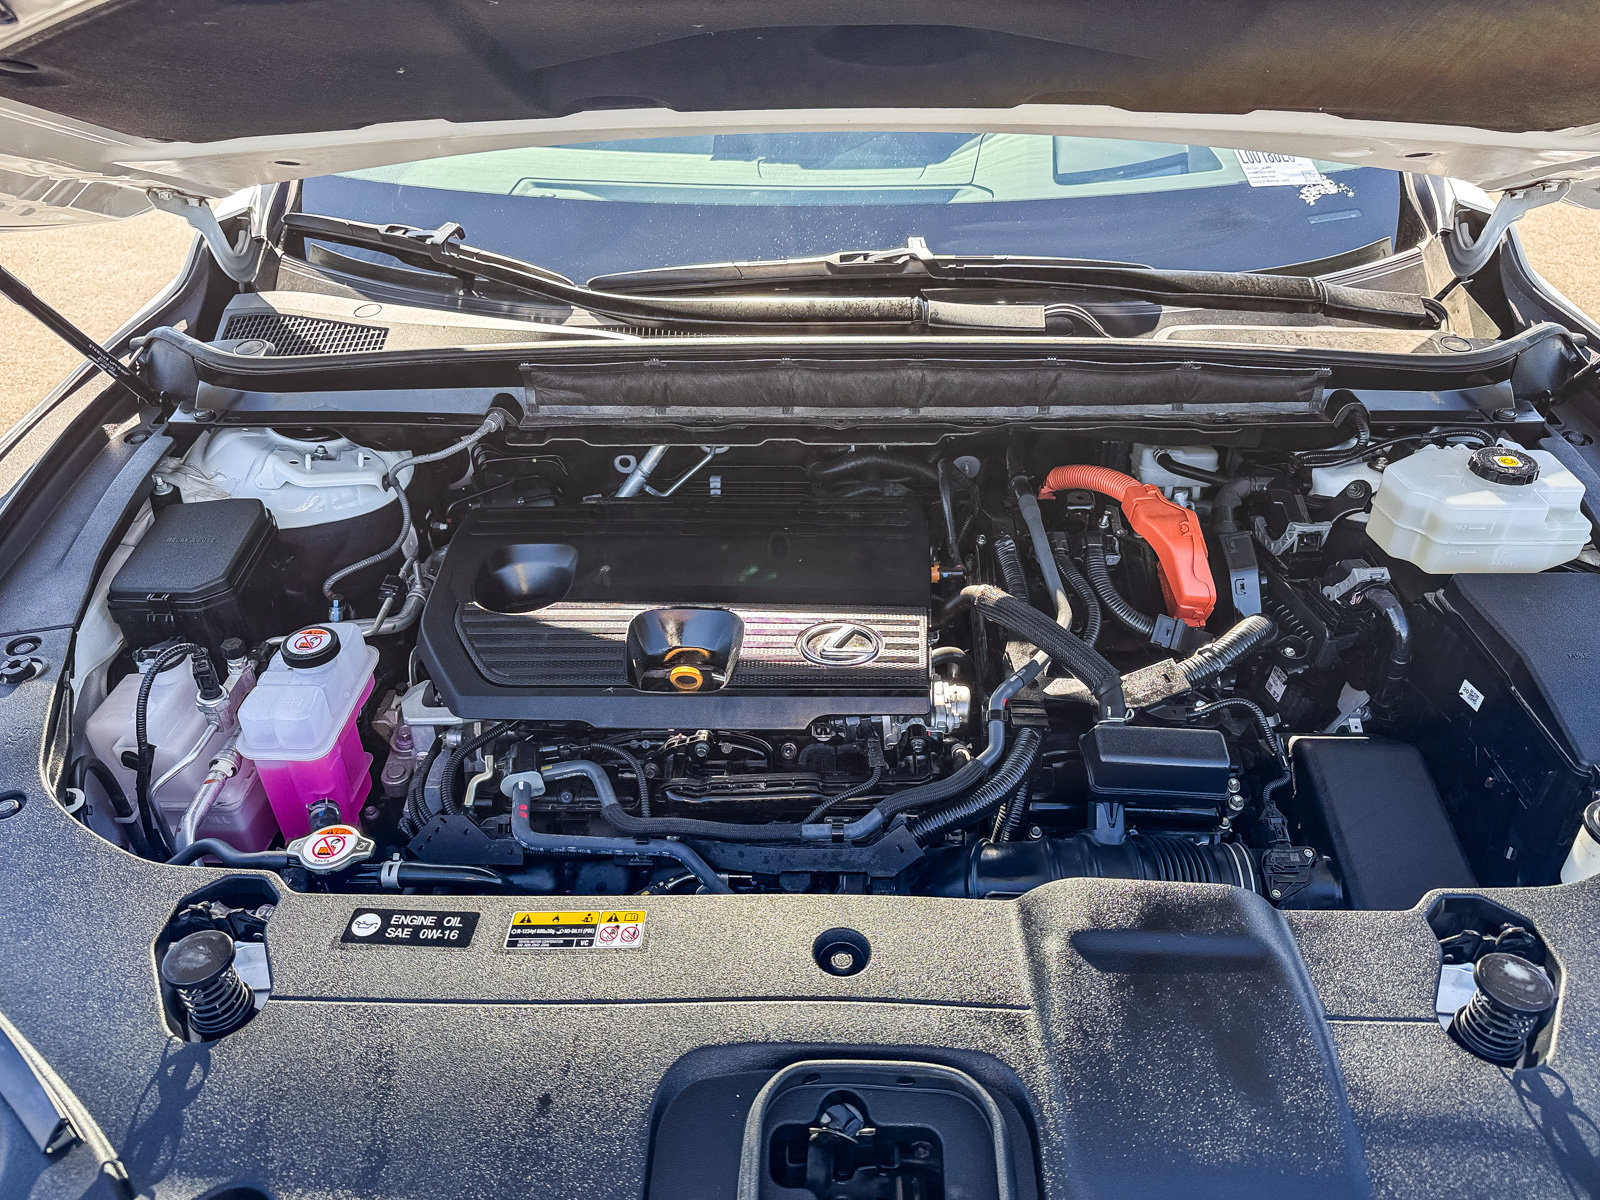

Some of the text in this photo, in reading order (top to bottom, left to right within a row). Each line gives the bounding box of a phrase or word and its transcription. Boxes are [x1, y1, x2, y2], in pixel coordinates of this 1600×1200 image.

[390, 914, 463, 927] ENGINE OIL
[385, 927, 459, 940] SAE 0W-16
